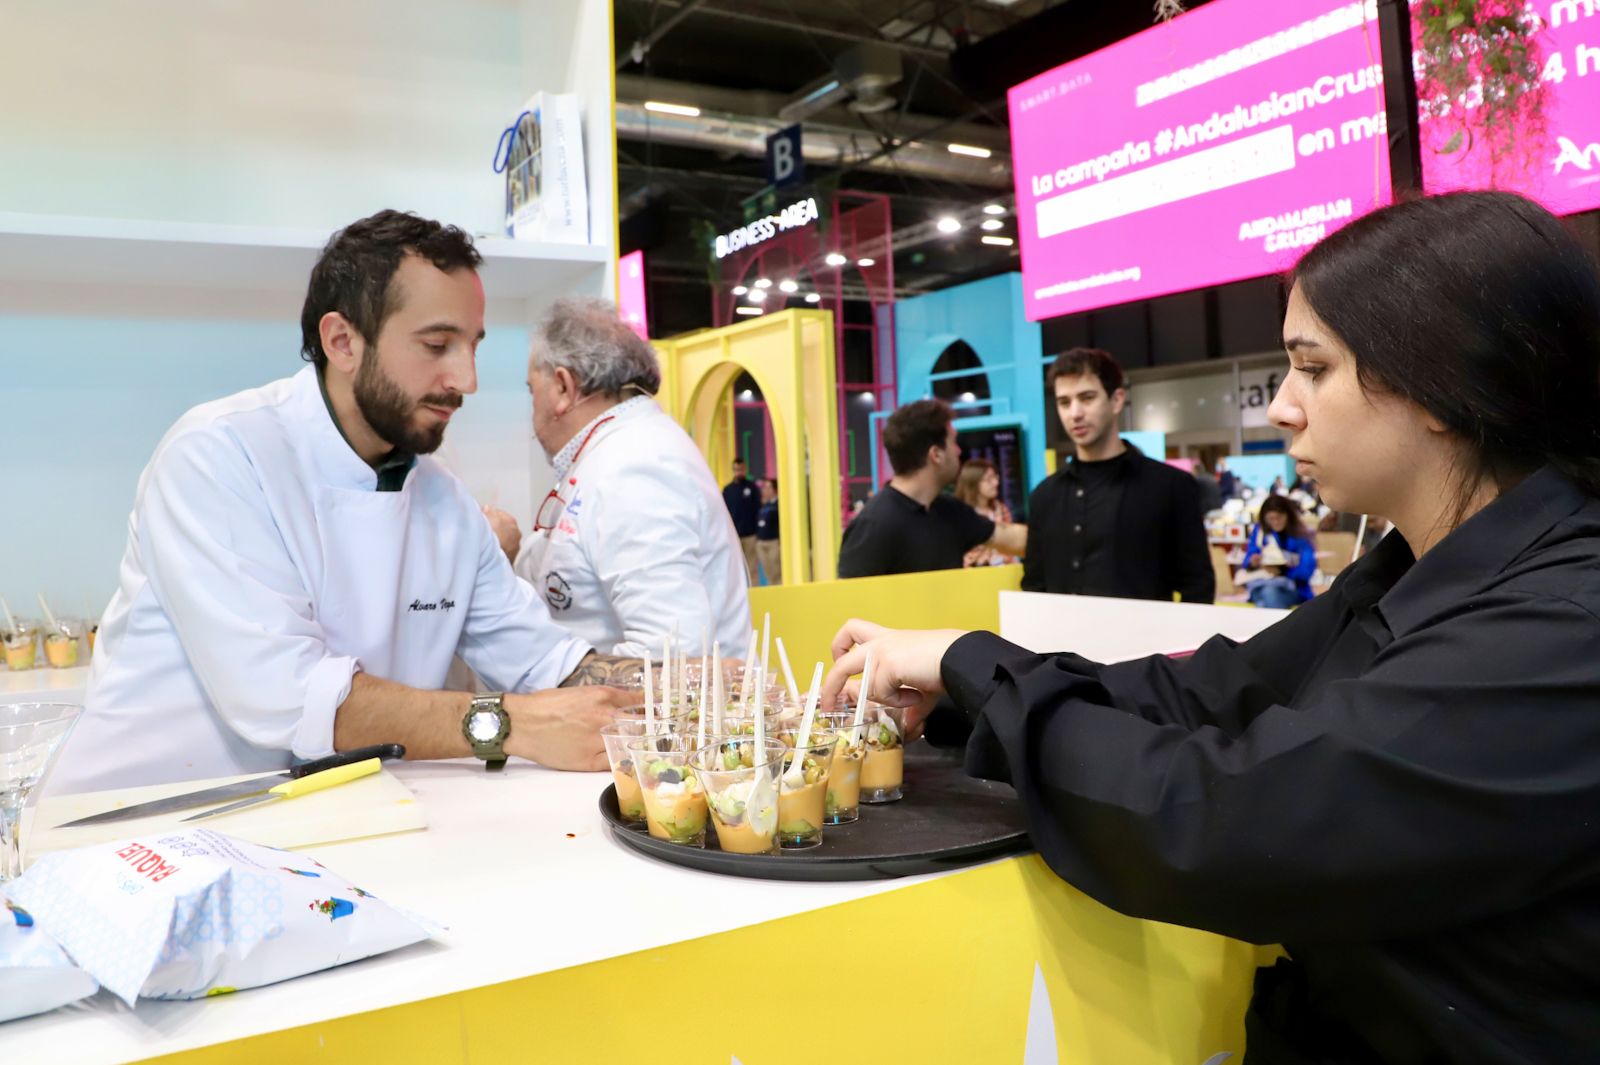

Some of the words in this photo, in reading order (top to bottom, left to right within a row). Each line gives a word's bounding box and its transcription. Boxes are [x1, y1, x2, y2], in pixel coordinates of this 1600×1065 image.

[1550, 0, 1600, 28] m
[773, 137, 795, 181] B
[1297, 127, 1336, 157] en
[1031, 174, 1054, 197] La
[1054, 140, 1151, 183] campaña
[716, 215, 776, 258] BUSINESS
[779, 197, 819, 232] AREA
[115, 842, 180, 882] RAQUEL
